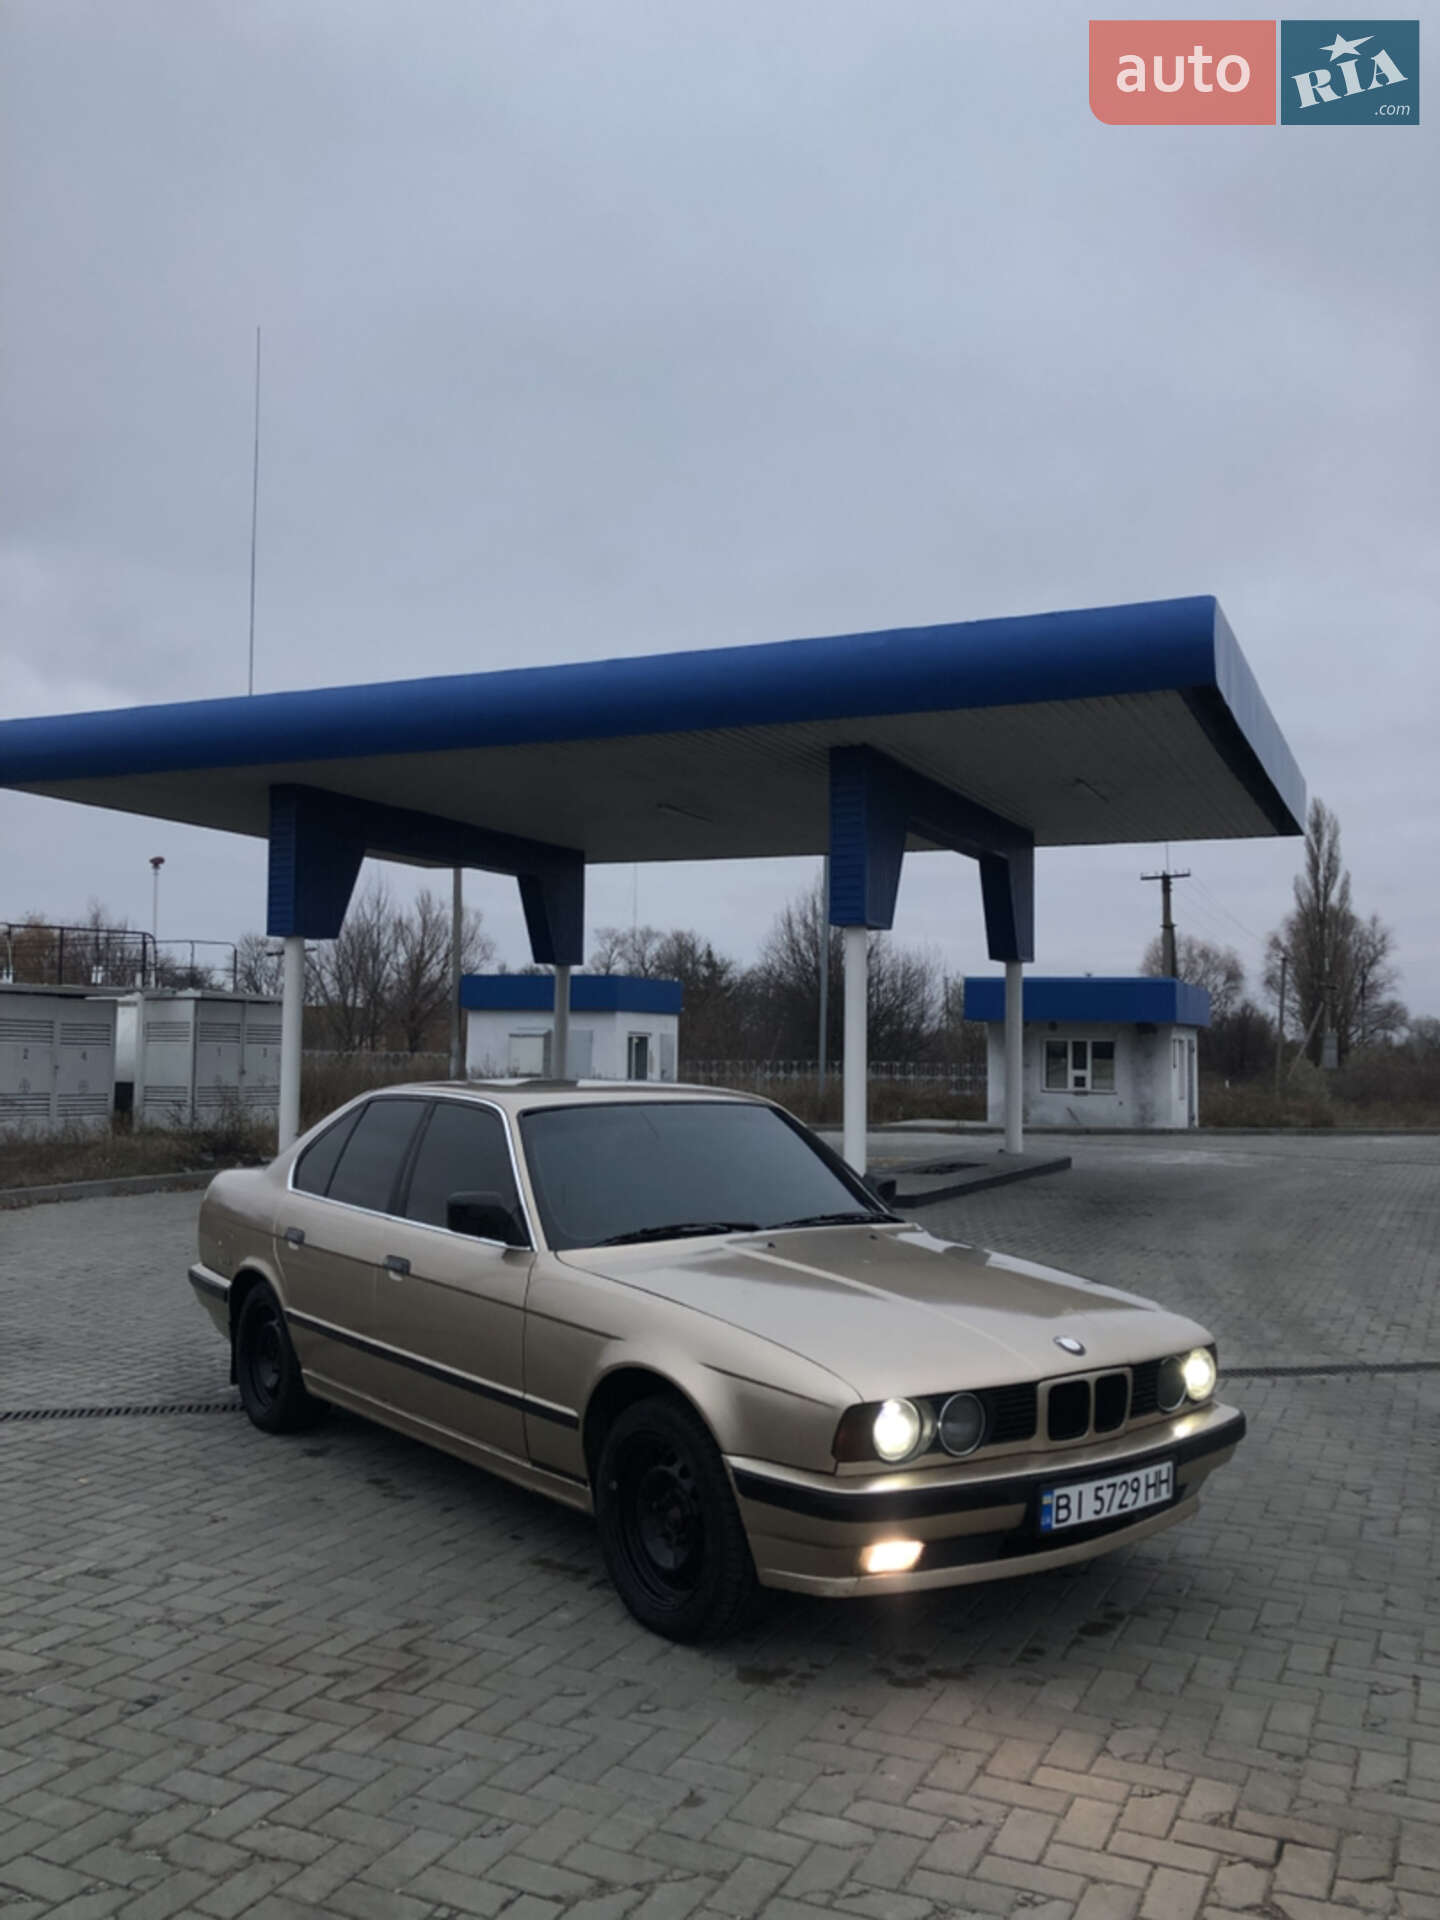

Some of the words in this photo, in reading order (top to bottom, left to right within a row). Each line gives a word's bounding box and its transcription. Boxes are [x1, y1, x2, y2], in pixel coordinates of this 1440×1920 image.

[1055, 1490, 1083, 1524] BI
[1093, 1477, 1141, 1515] 5729
[1144, 1466, 1172, 1502] HH
